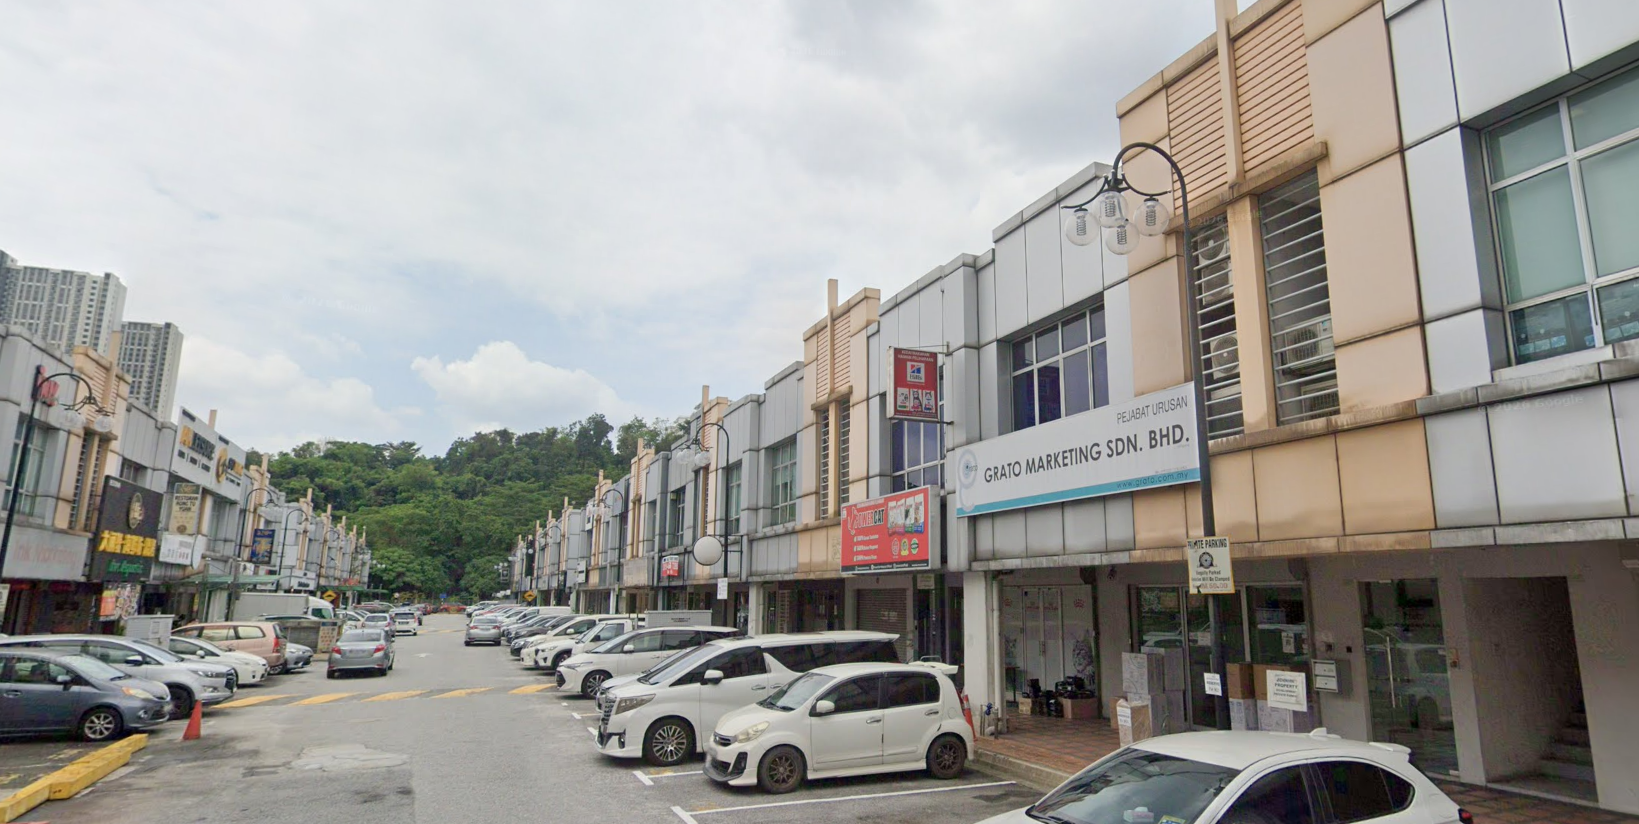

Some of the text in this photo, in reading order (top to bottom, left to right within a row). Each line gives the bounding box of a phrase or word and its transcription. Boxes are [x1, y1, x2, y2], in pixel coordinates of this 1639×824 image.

[1117, 396, 1188, 424] PEJABAT URUSAN
[984, 423, 1190, 483] GRATO MARKETING SDN. BHD.
[1187, 538, 1228, 550] PRIATE PARKING
